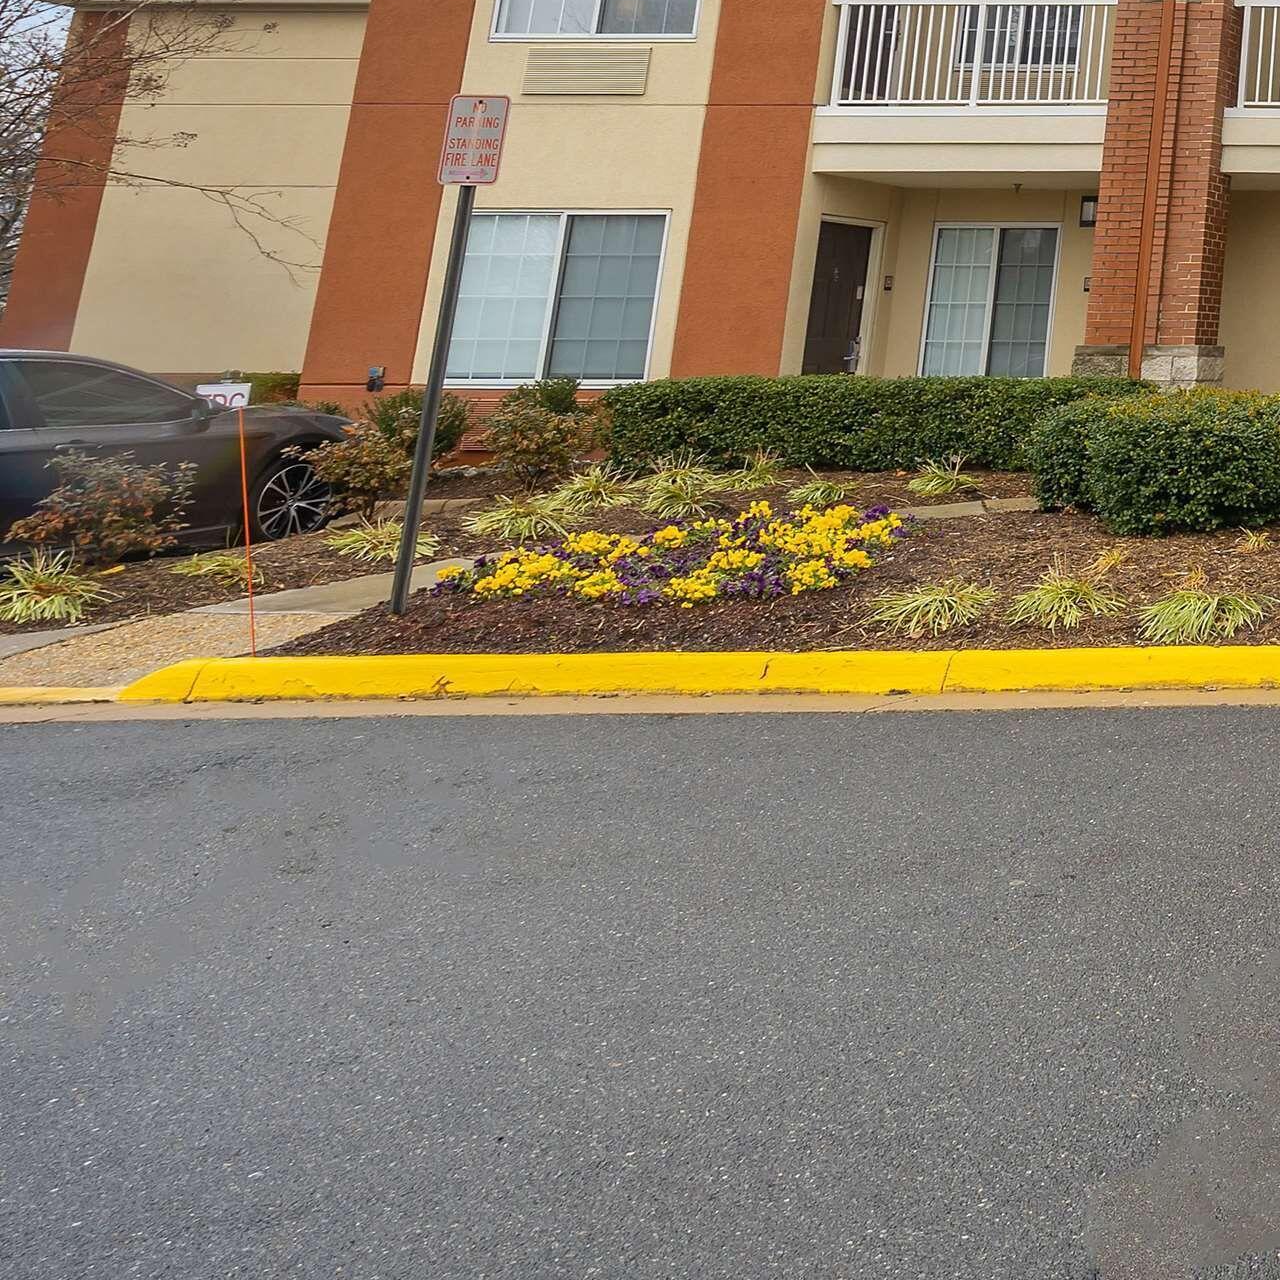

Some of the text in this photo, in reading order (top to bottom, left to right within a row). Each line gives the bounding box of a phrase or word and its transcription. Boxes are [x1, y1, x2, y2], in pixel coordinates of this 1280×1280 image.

[455, 116, 500, 129] PARING
[448, 138, 499, 150] STANDING
[444, 153, 468, 167] FIRE
